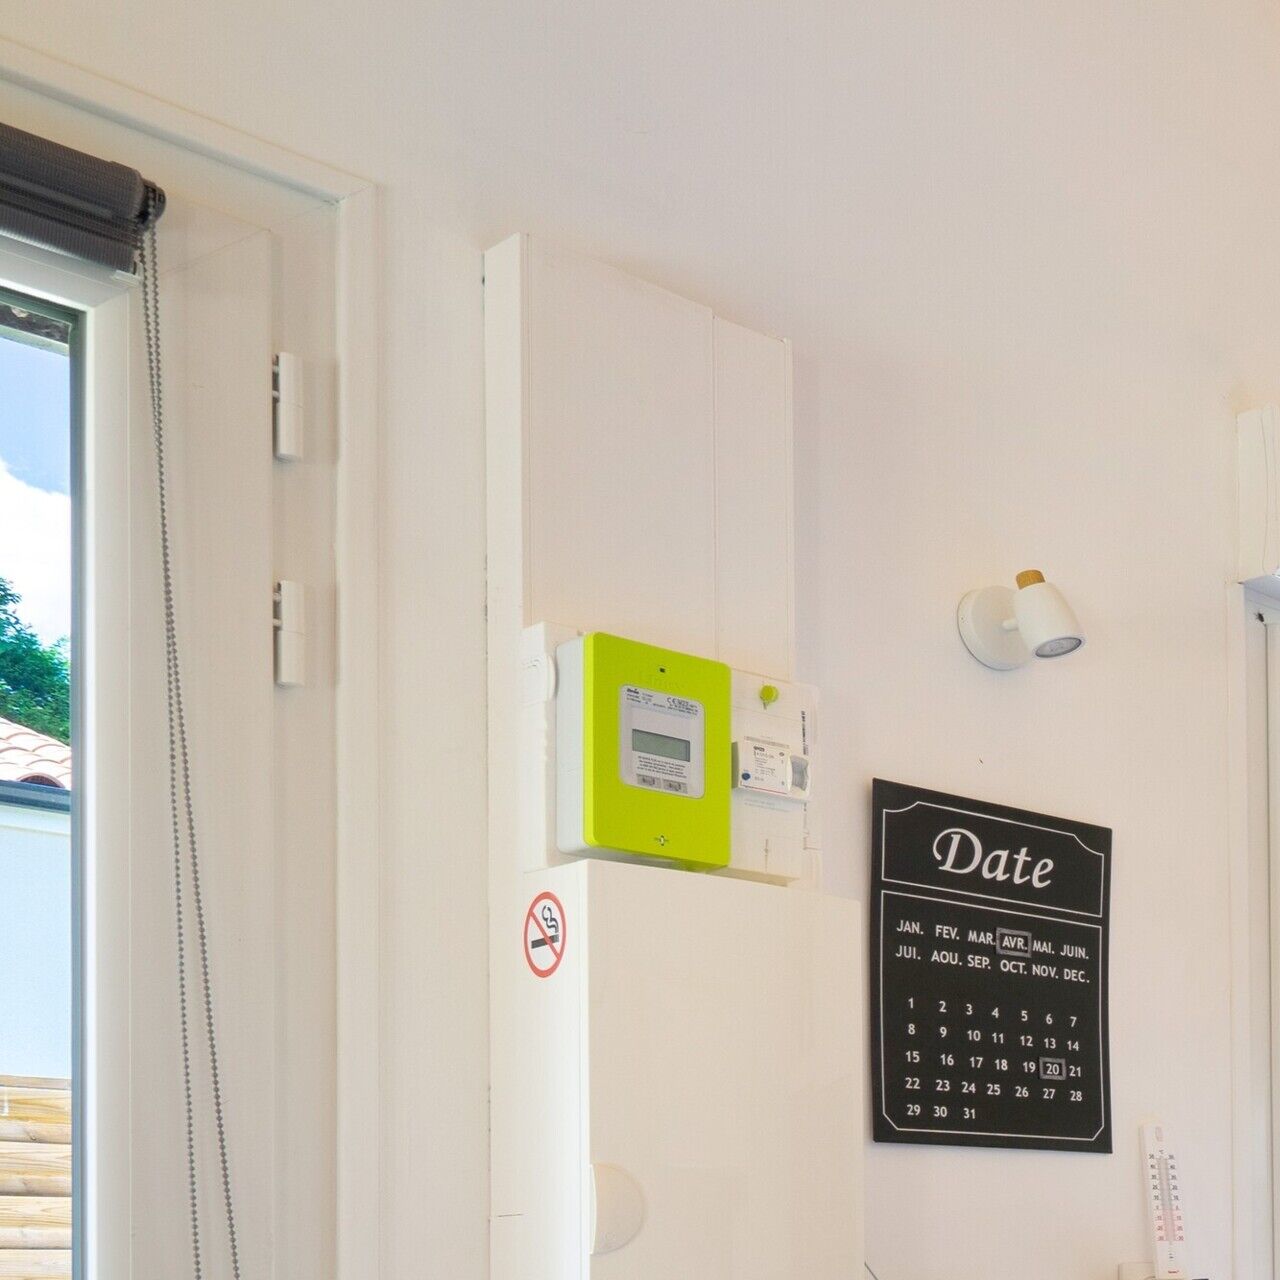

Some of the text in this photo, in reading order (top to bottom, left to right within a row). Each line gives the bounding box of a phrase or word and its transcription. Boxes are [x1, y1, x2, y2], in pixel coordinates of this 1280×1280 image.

[933, 827, 1054, 889] Date
[897, 920, 1088, 959] JAN. FEV. MAR. AVR. MAI. JUIN.
[896, 945, 1089, 983] JUI. AOU. SEP. OCT. NOV. DEC.
[909, 998, 1076, 1027] 1 2 3 4 5 6 7
[908, 1024, 1079, 1051] 8 9 10 11 12 13 14
[906, 1051, 1080, 1077] 15 16 17 18 19 20 21
[906, 1077, 1082, 1101] 22 23 24 25 26 27 28
[907, 1104, 975, 1119] 29 30 31
